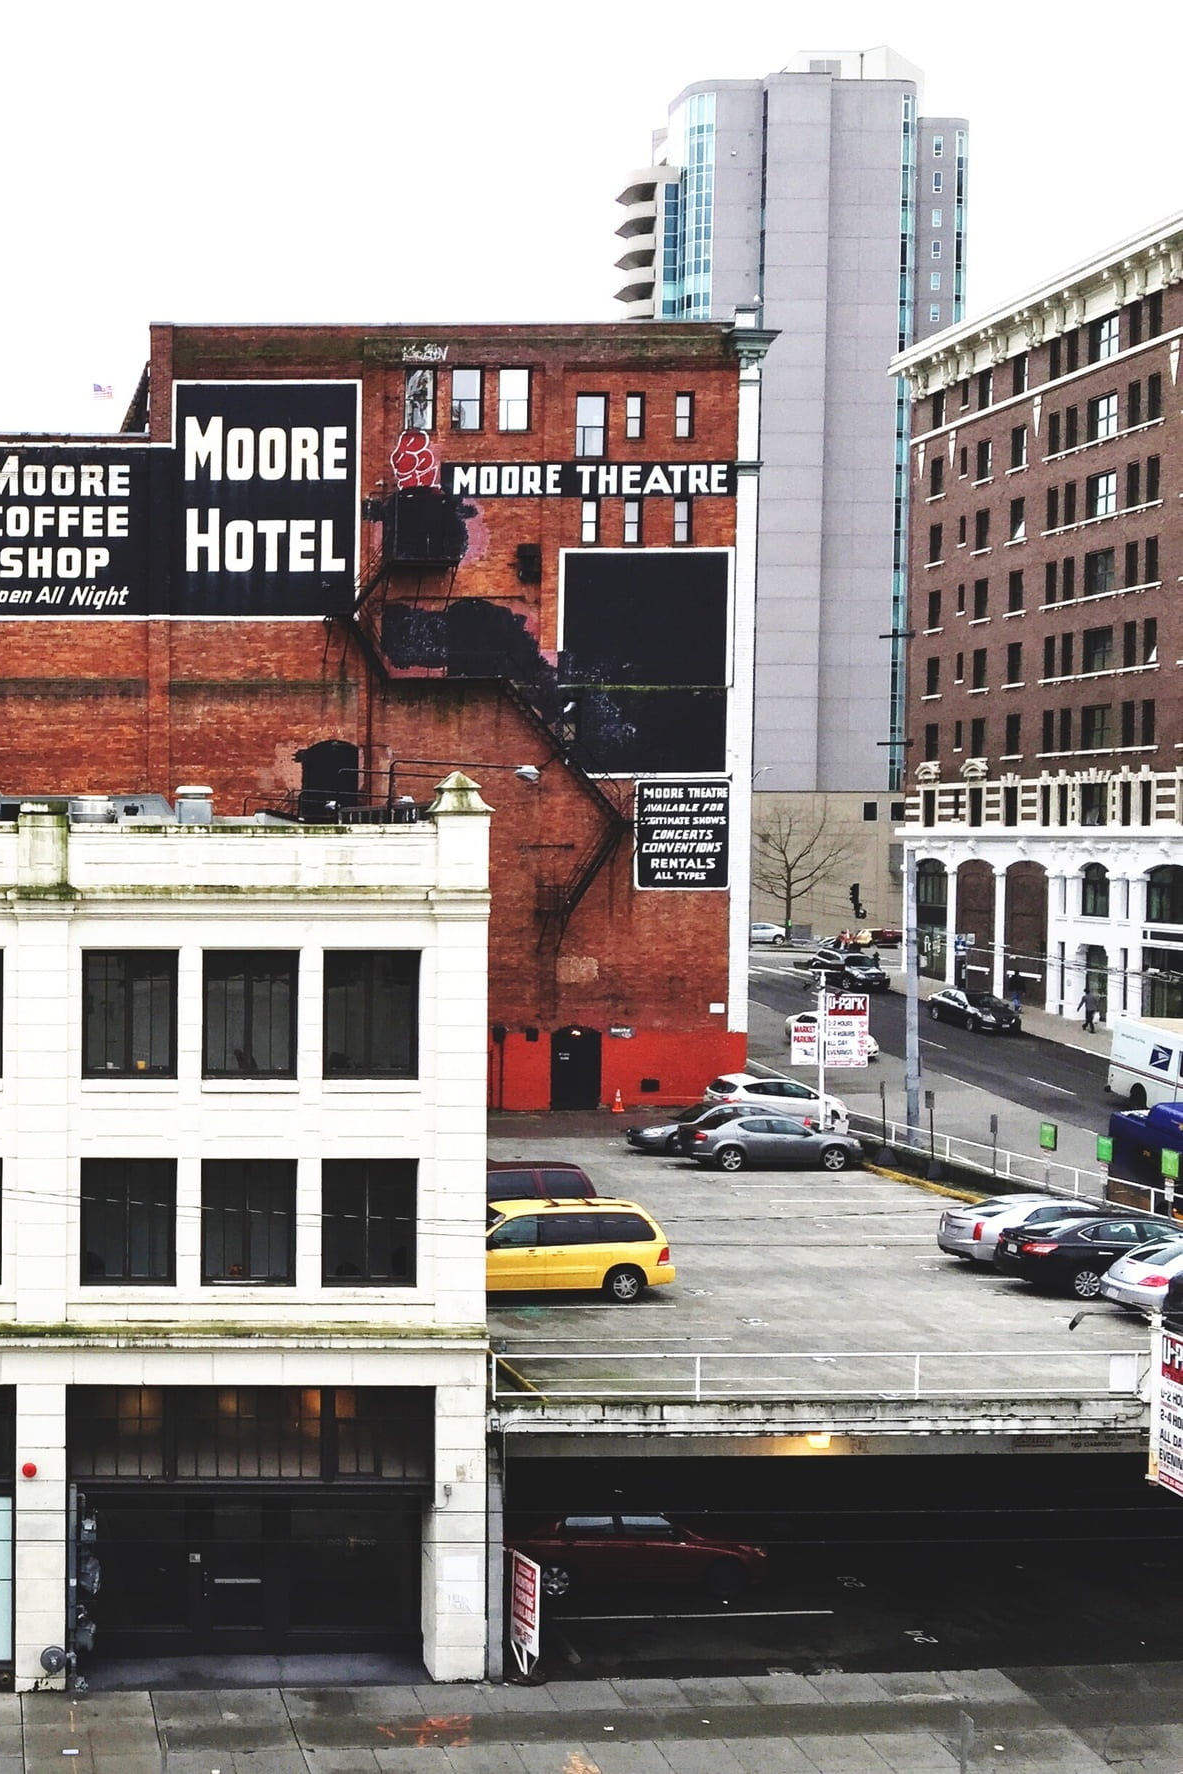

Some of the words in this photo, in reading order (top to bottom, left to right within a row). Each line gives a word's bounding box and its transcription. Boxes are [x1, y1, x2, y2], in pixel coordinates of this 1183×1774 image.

[184, 416, 348, 481] MOORE
[453, 465, 562, 495] MOORE
[576, 464, 728, 495] THEATRE
[185, 507, 346, 573] HOTEL
[0, 547, 110, 579] SHOP
[35, 585, 65, 604] All
[68, 585, 129, 610] Night
[643, 787, 685, 799] MOORE
[687, 787, 728, 799] THEATRE
[643, 803, 700, 812] AVAILABLE
[702, 803, 724, 812] FOR
[692, 816, 727, 825] SHOWS
[652, 829, 714, 840] CONCERTS
[641, 842, 723, 853] CONVENTIONS
[650, 858, 716, 869] RENTALS
[654, 872, 674, 880] ALL
[676, 872, 707, 880] TYPES
[793, 1035, 816, 1043] PARKING
